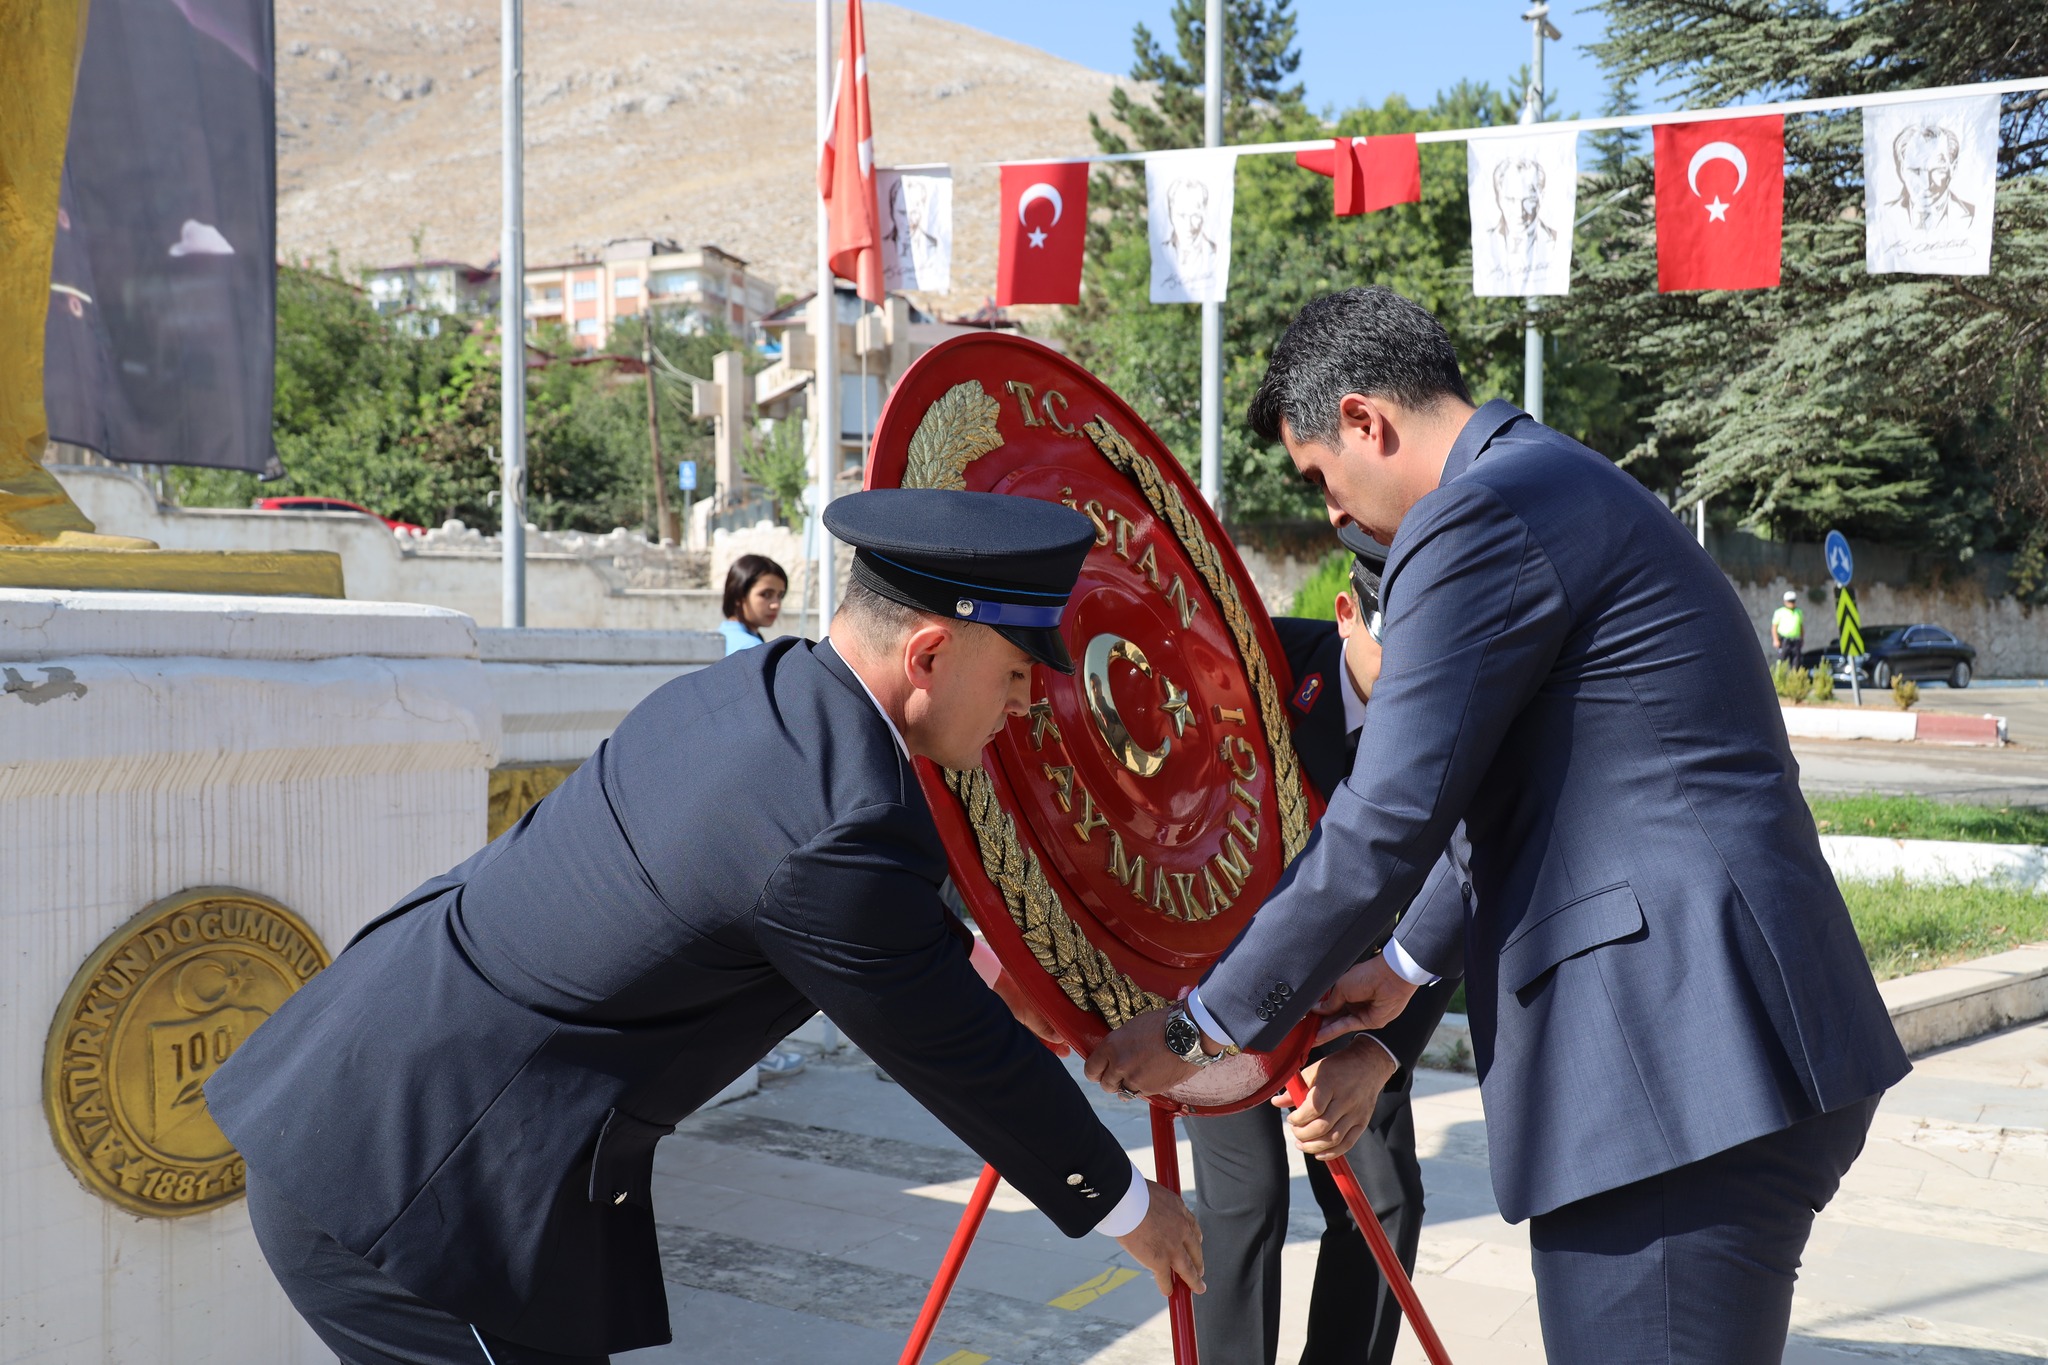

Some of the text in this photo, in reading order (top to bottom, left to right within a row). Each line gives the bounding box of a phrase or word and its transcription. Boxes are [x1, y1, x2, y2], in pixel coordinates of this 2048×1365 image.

[1005, 380, 1084, 437] T.C.
[1027, 697, 1261, 923] KAYMAKAMLIĞI
[171, 1024, 232, 1083] 100
